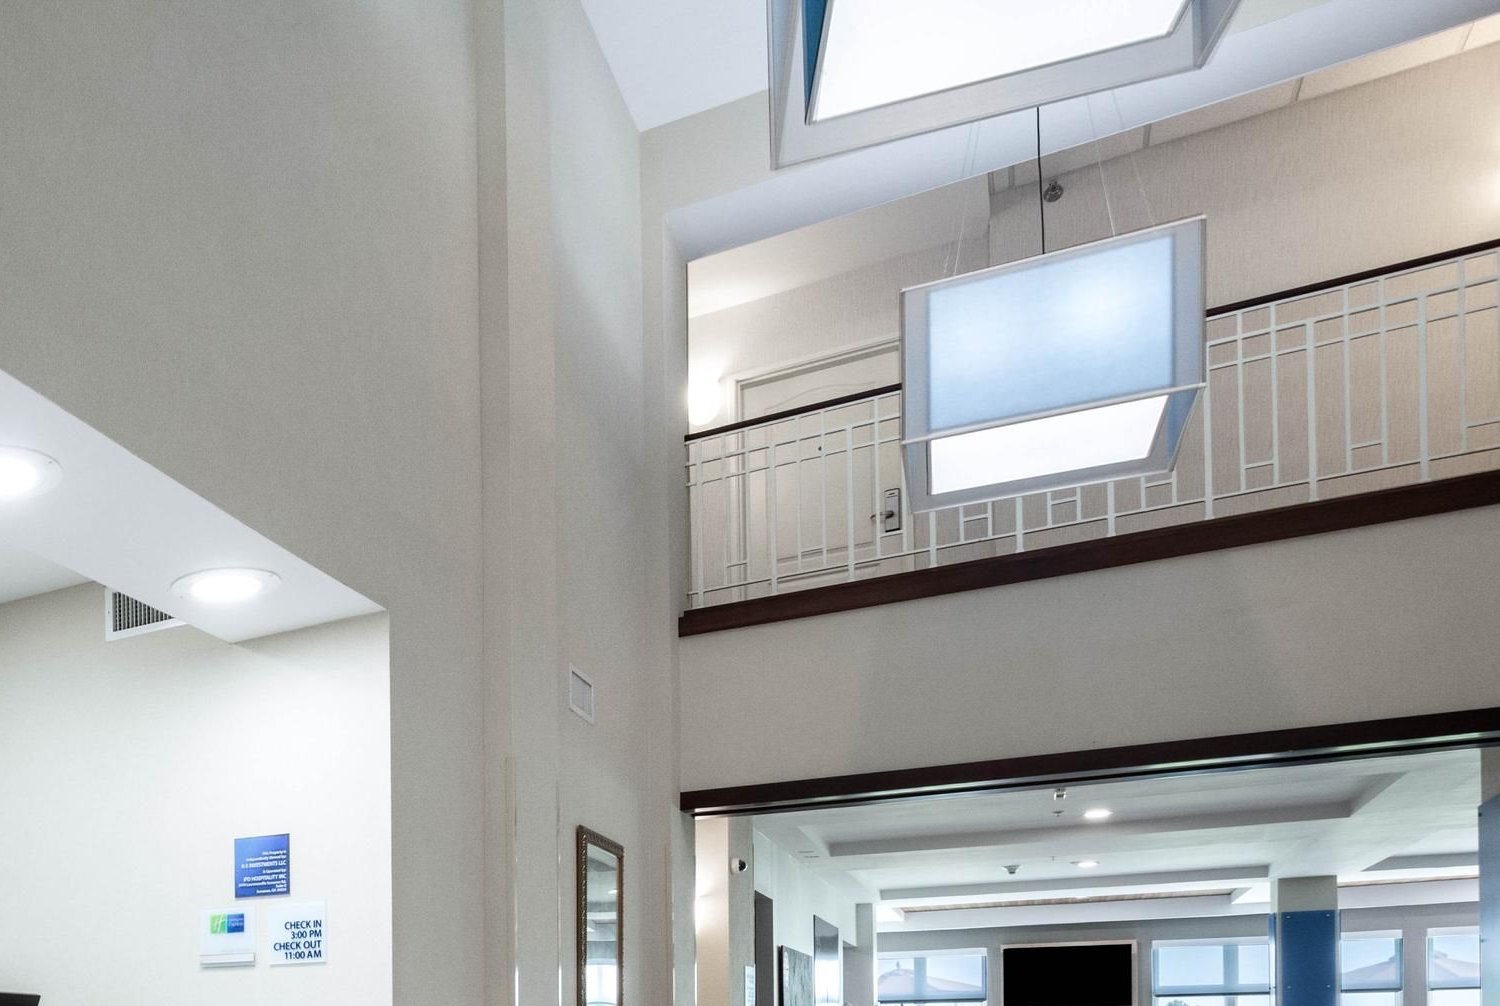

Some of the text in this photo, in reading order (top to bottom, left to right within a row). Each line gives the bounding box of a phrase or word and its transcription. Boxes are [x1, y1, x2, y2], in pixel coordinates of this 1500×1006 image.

[284, 919, 322, 930] CHECK IN
[290, 929, 322, 940] 3:00 PM
[273, 940, 322, 951] CHECK OUT
[284, 949, 322, 960] 11:00 AM
